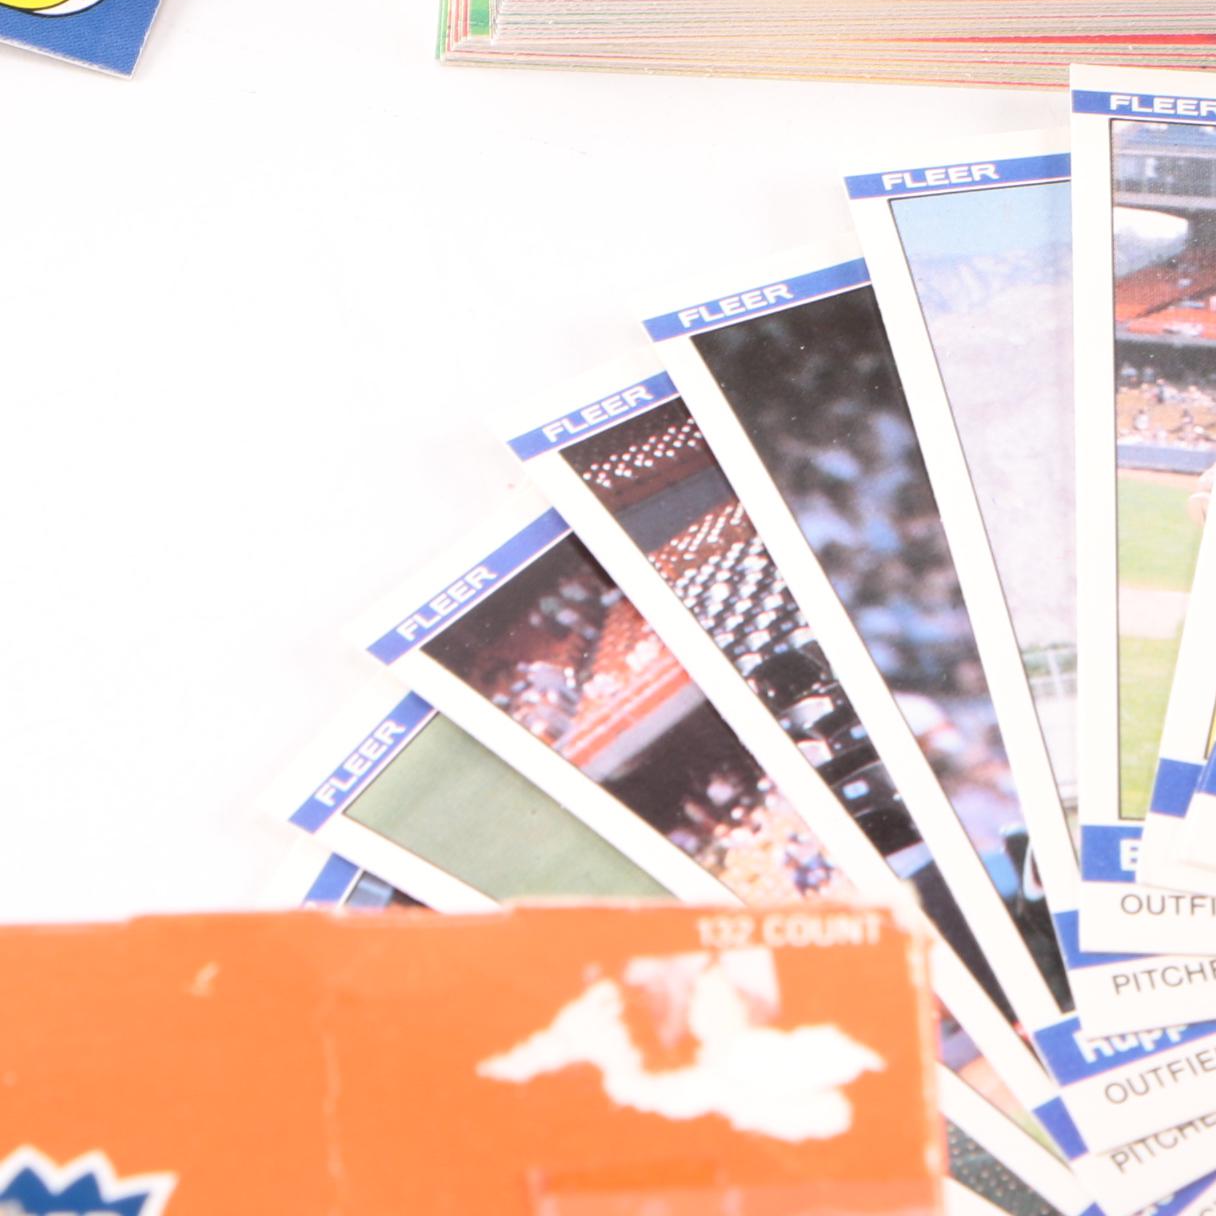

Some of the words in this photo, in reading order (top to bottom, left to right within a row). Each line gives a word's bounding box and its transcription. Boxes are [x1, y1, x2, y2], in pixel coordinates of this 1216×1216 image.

[881, 164, 1001, 191] FLEER
[678, 283, 795, 329] FLEER
[541, 384, 655, 444] FLEER
[395, 565, 498, 642] FLEER
[313, 720, 406, 809] FLEER
[762, 912, 881, 948] COUNT
